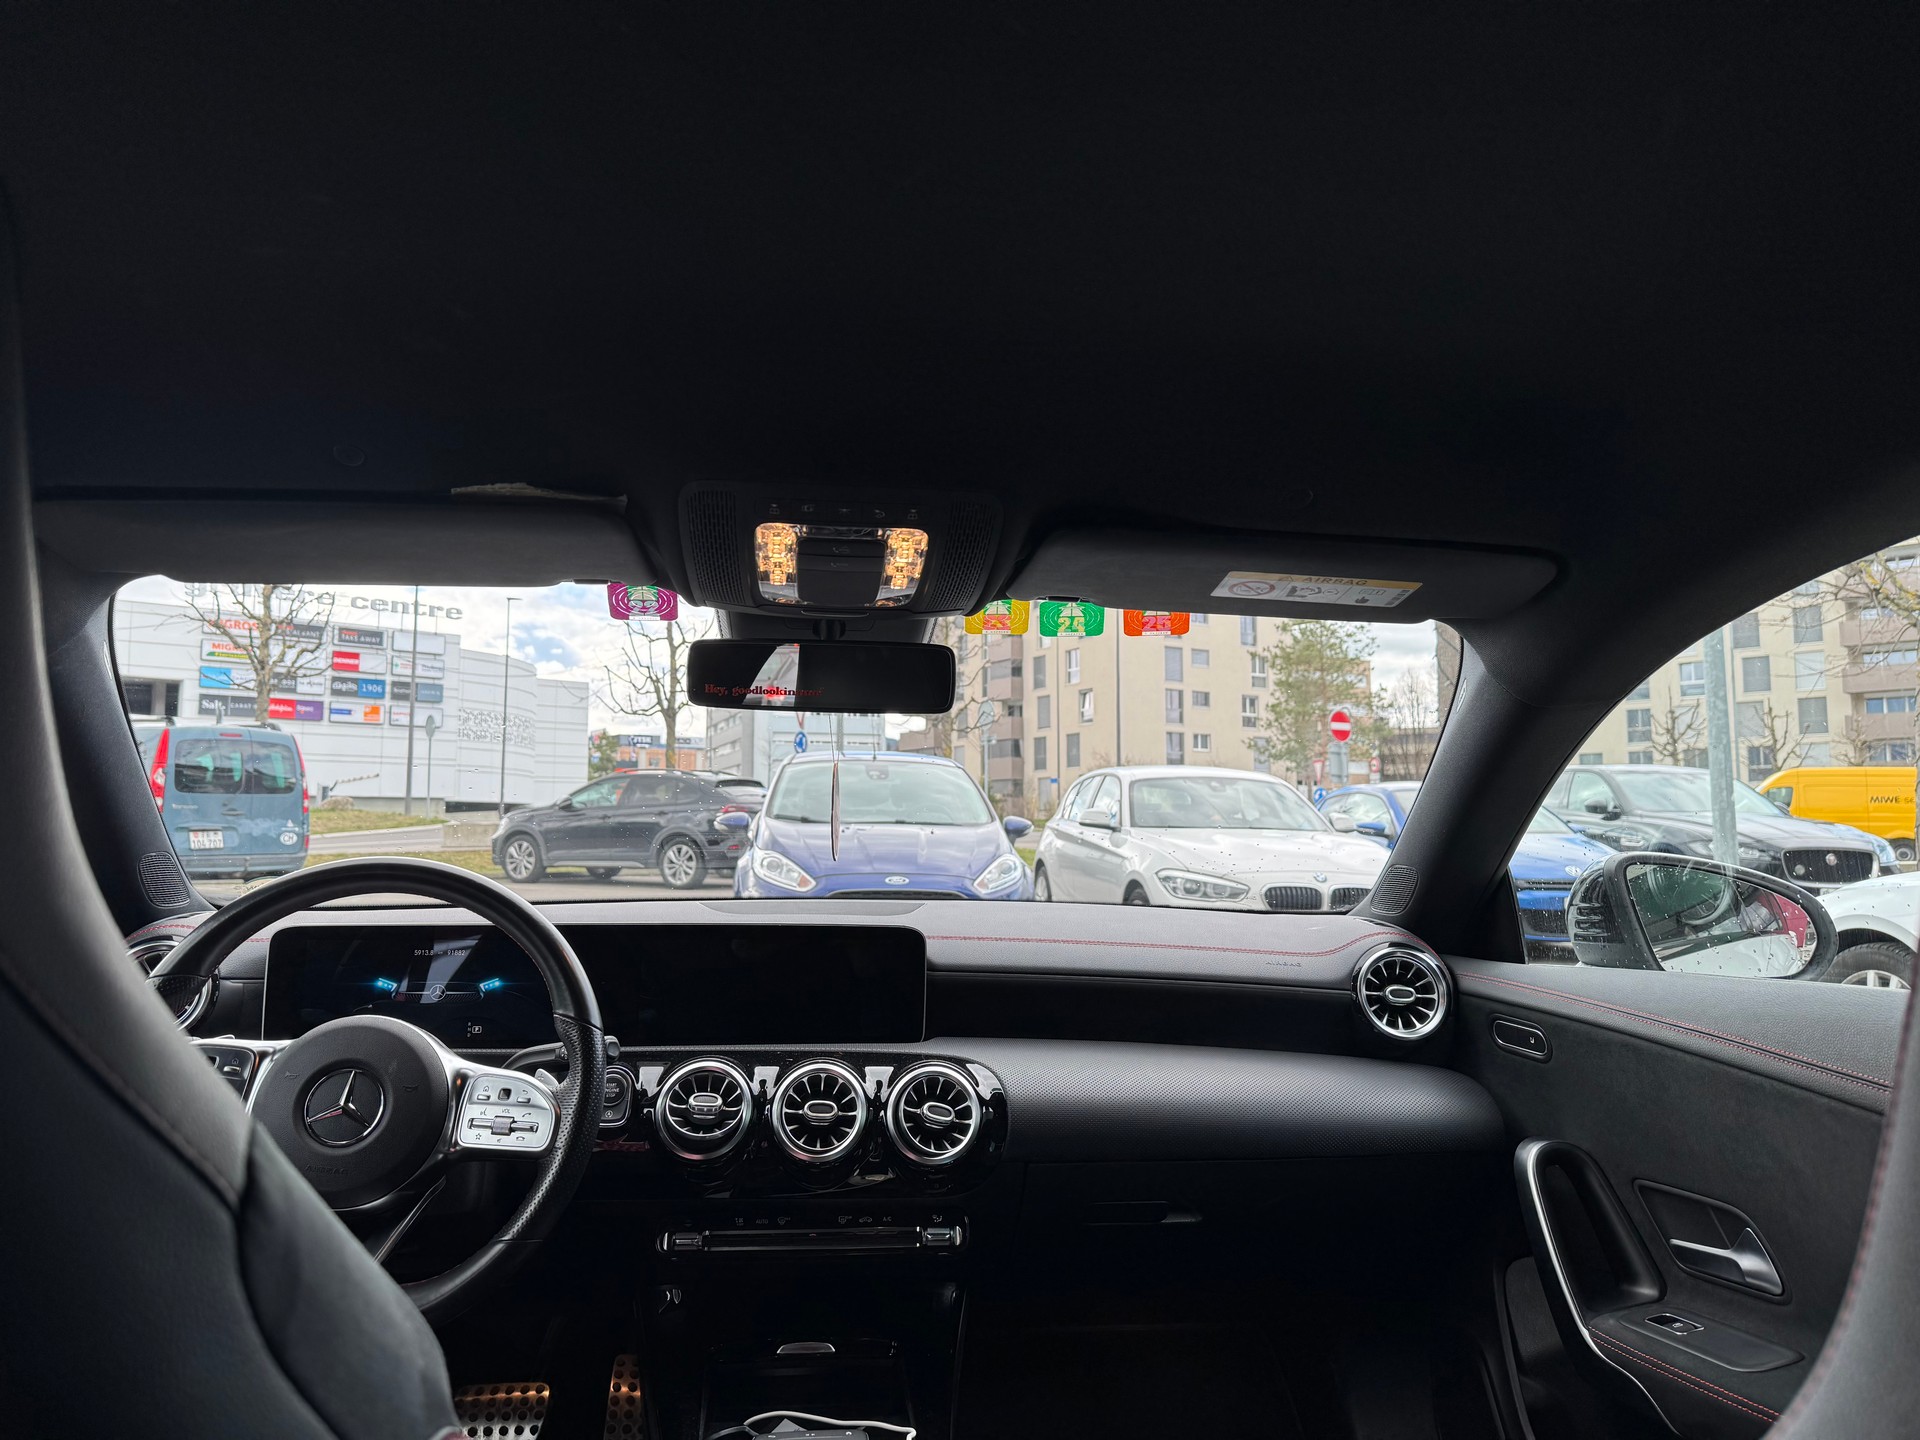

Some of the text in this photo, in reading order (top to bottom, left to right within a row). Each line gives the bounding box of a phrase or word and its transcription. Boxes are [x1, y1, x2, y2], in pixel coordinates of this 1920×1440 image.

[1303, 576, 1368, 586] AIRBAG
[350, 596, 463, 620] centre
[362, 684, 383, 693] 1906
[704, 683, 728, 696] Hey,
[282, 833, 296, 842] CH
